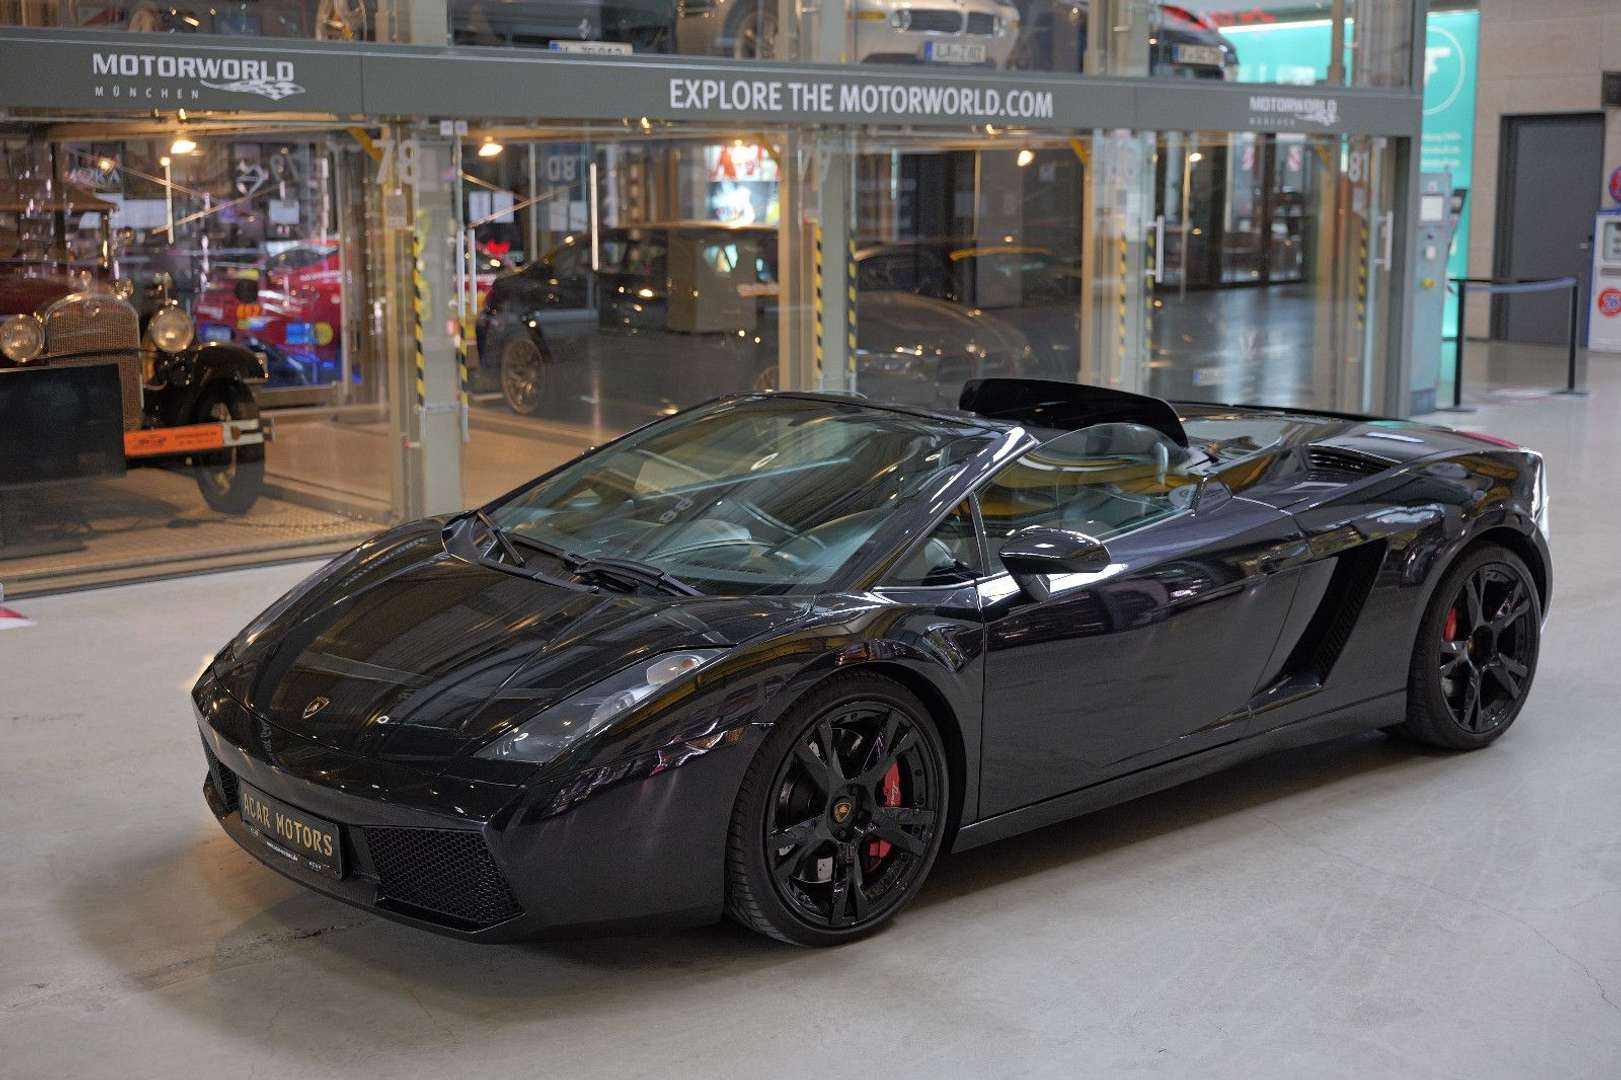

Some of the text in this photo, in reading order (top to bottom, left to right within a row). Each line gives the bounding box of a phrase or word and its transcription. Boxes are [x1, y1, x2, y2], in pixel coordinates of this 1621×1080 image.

[93, 53, 294, 81] MOTORWORLD
[95, 85, 198, 99] MÜNCHEN
[669, 78, 1053, 118] EXPLORE THE MOTORWORLD.COM
[275, 812, 333, 856] MOTORS
